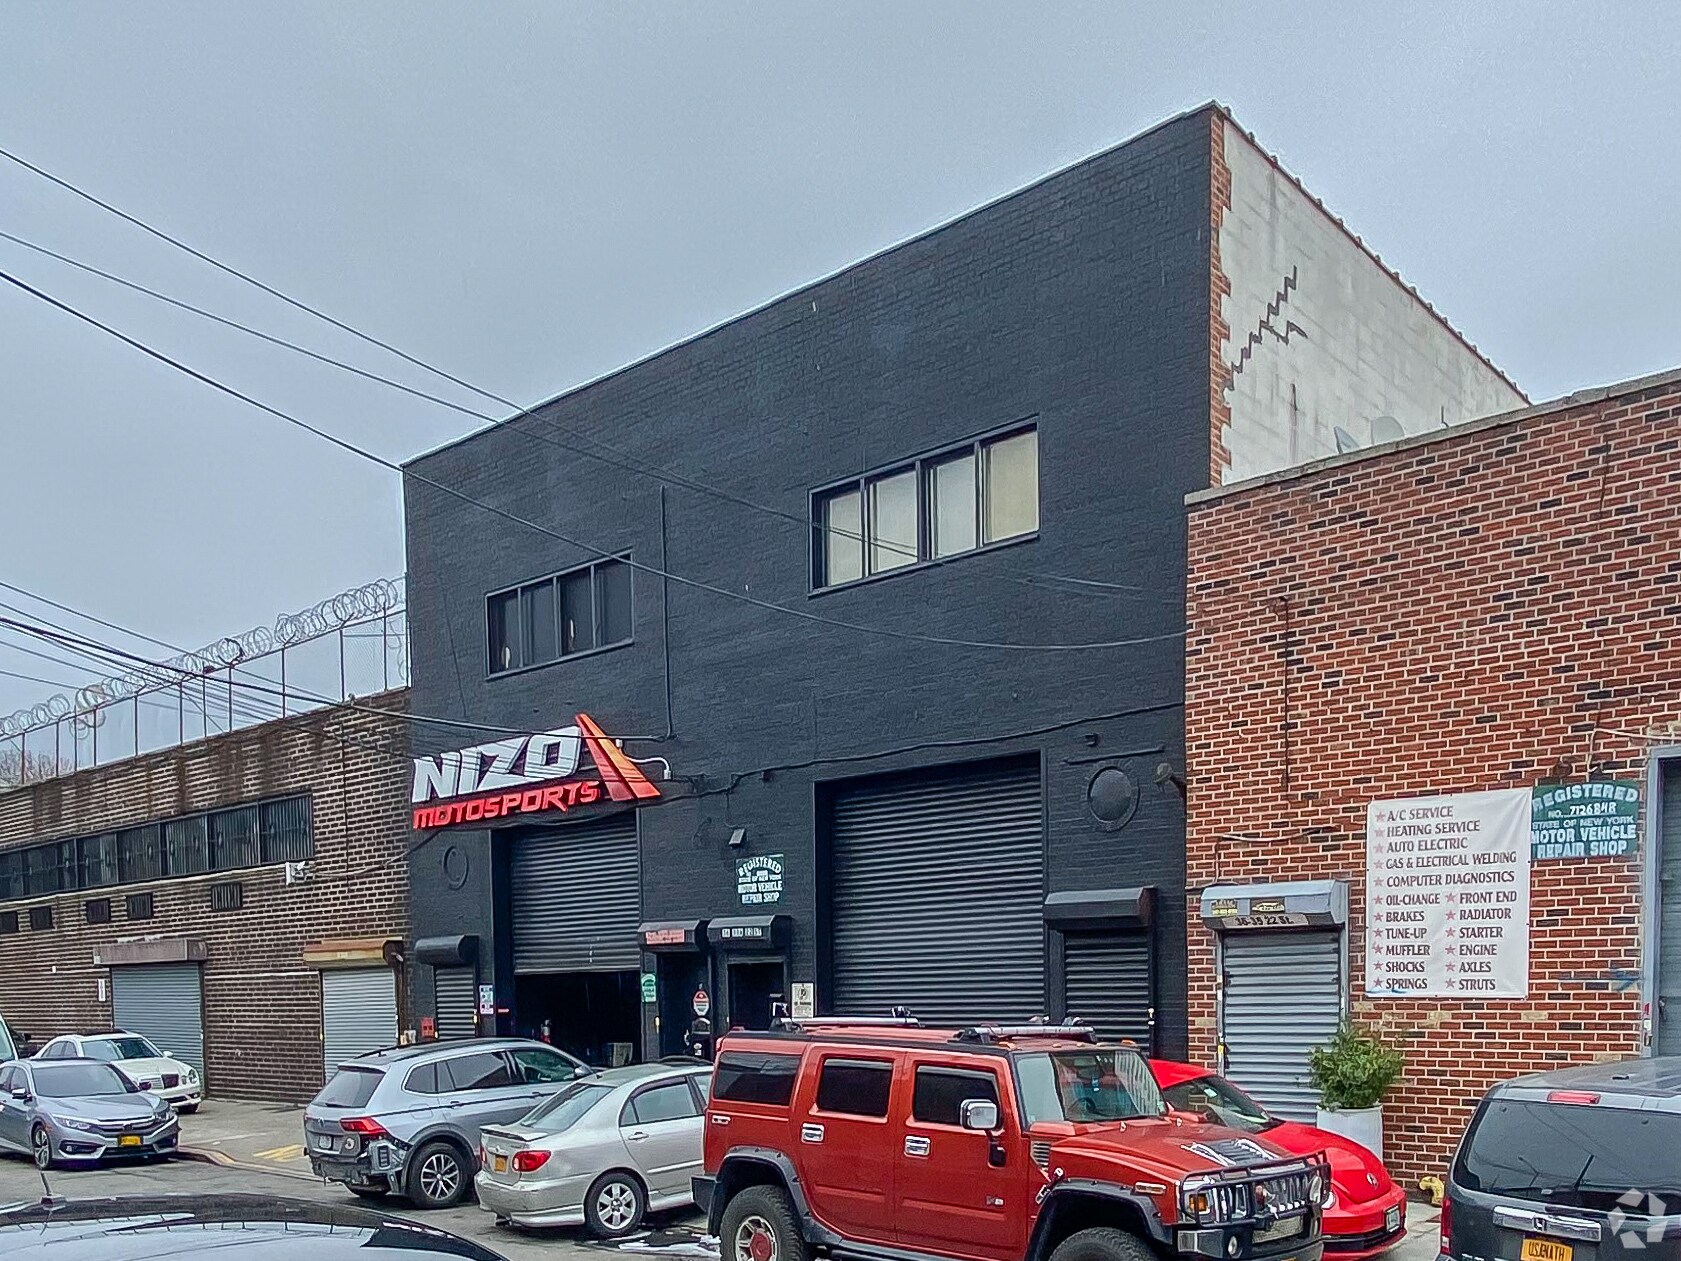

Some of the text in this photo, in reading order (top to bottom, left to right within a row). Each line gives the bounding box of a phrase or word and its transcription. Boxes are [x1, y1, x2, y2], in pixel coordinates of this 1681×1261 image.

[412, 725, 582, 803] NIZO
[1531, 783, 1639, 812] REGISTERED
[413, 781, 600, 829] MOTOSPORTS
[1387, 806, 1453, 821] A/C SERVICE
[1387, 820, 1480, 837] HEATING SERVICE
[1531, 815, 1635, 830] STATE OF NEW YORK
[1530, 824, 1637, 844] MOTOR VEHICLE
[1387, 837, 1468, 853] AUTO ELECTRIC
[1536, 840, 1627, 858] REPAIR SHOP
[1386, 851, 1516, 869] GAS & ELECTRICAL WELDING
[1387, 871, 1514, 887] COMPUTER DIAGNOSTICS
[1386, 893, 1440, 906] OIL-CHANGE
[1460, 891, 1517, 904] FRONT END
[1386, 911, 1424, 922] BRAKES
[1460, 908, 1511, 920] RADIATOR
[1385, 928, 1427, 939] TUNE-UP
[1459, 927, 1503, 938] STARTER
[1386, 945, 1430, 956] MUFFLER
[1459, 944, 1497, 956] ENGINE
[1386, 961, 1425, 972] SHOCKS
[1459, 961, 1491, 972] AXLES
[1386, 978, 1427, 989] SPRINGS
[1459, 979, 1496, 990] STRUTS
